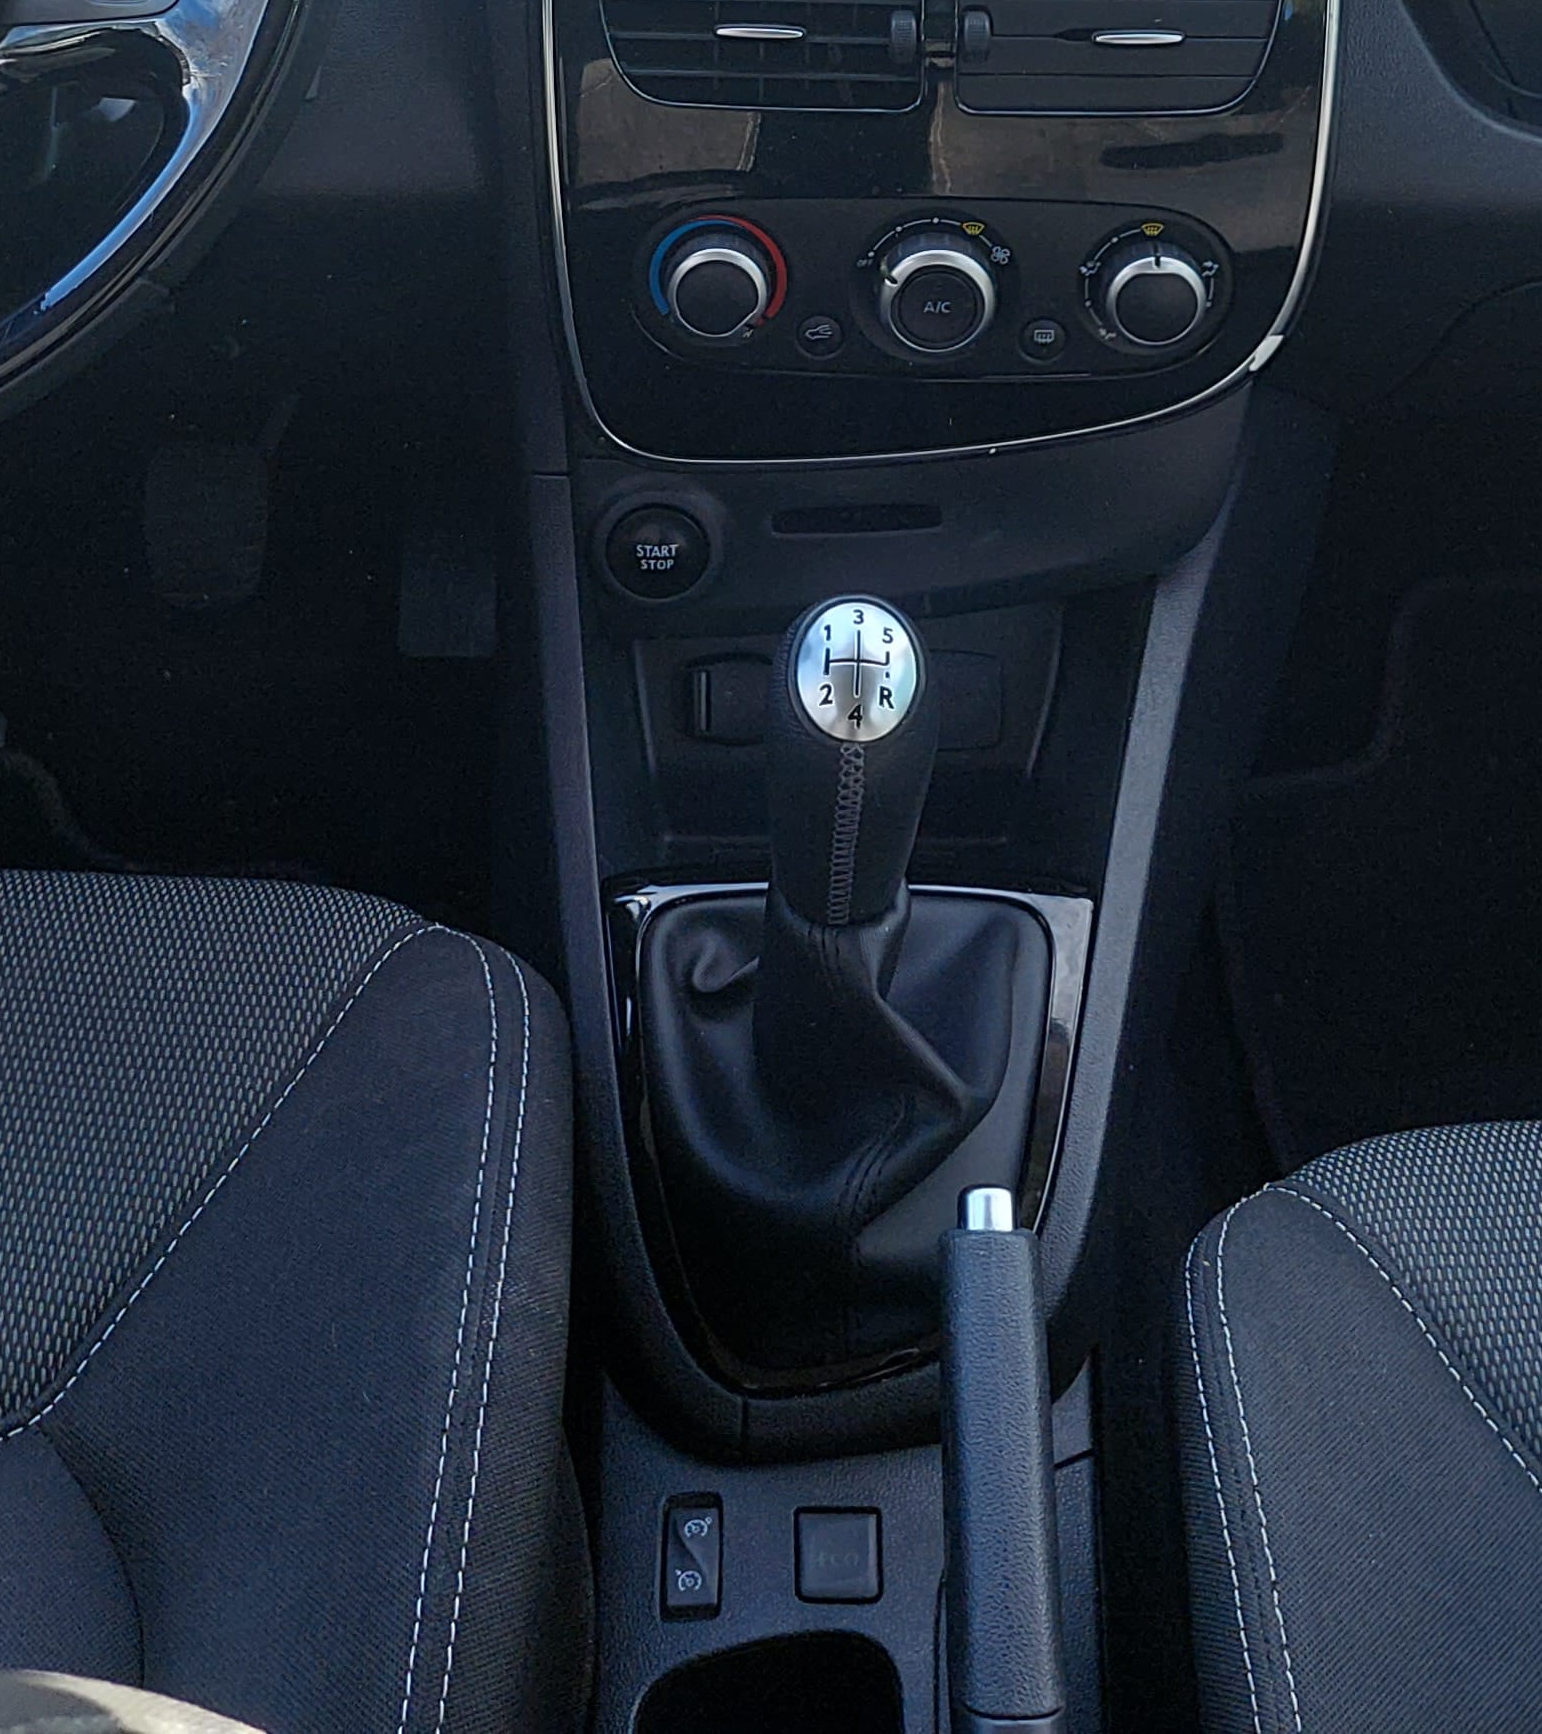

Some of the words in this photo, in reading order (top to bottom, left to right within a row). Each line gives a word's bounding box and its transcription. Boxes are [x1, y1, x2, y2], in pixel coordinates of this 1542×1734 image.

[922, 300, 952, 315] A/C
[635, 543, 680, 558] START
[639, 558, 675, 571] STOP
[852, 610, 865, 625] 3
[823, 625, 832, 642] 1
[881, 627, 893, 645] 5
[818, 685, 834, 707] 2
[879, 686, 895, 710] R
[847, 705, 864, 730] 4
